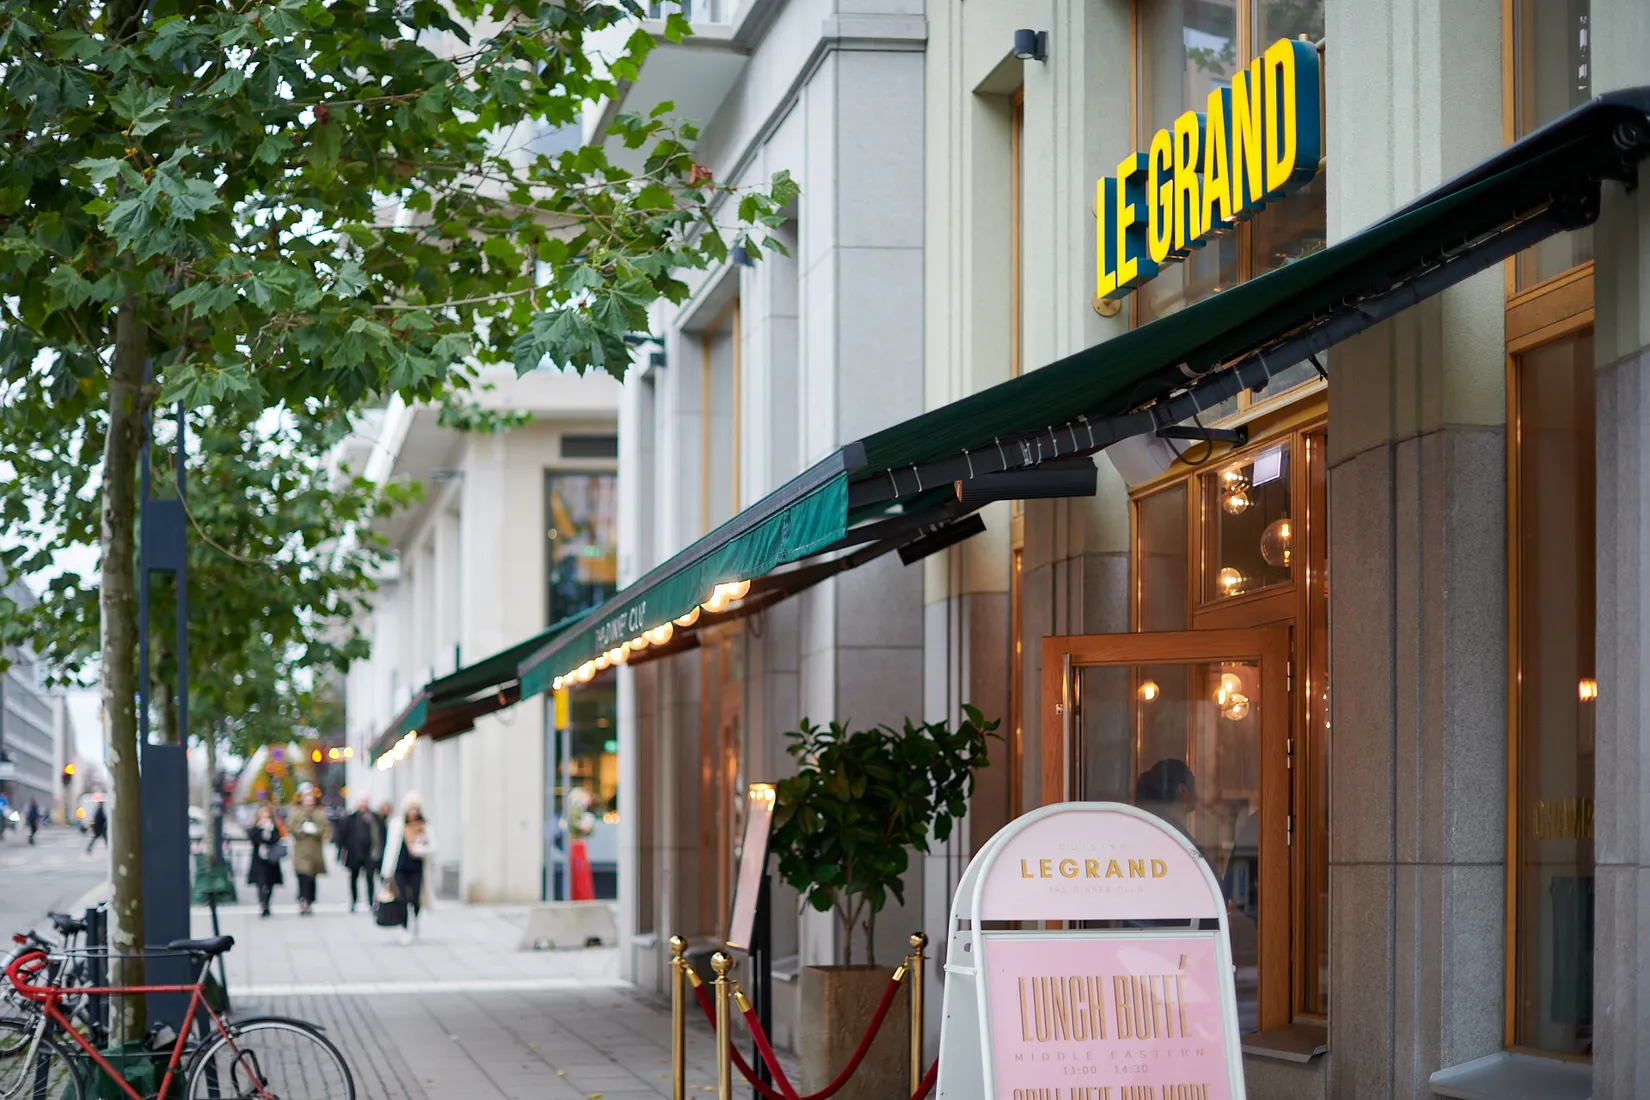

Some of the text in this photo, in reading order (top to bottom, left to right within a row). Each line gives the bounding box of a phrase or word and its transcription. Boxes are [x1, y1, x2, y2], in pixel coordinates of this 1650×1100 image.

[1021, 858, 1168, 879] LEGRAND
[1018, 954, 1193, 1042] LUNCH BUFFÉ
[1015, 1048, 1204, 1062] MIDDLE EASTERN
[1063, 1065, 1097, 1075] 11:00
[1114, 1064, 1148, 1074] 14:30
